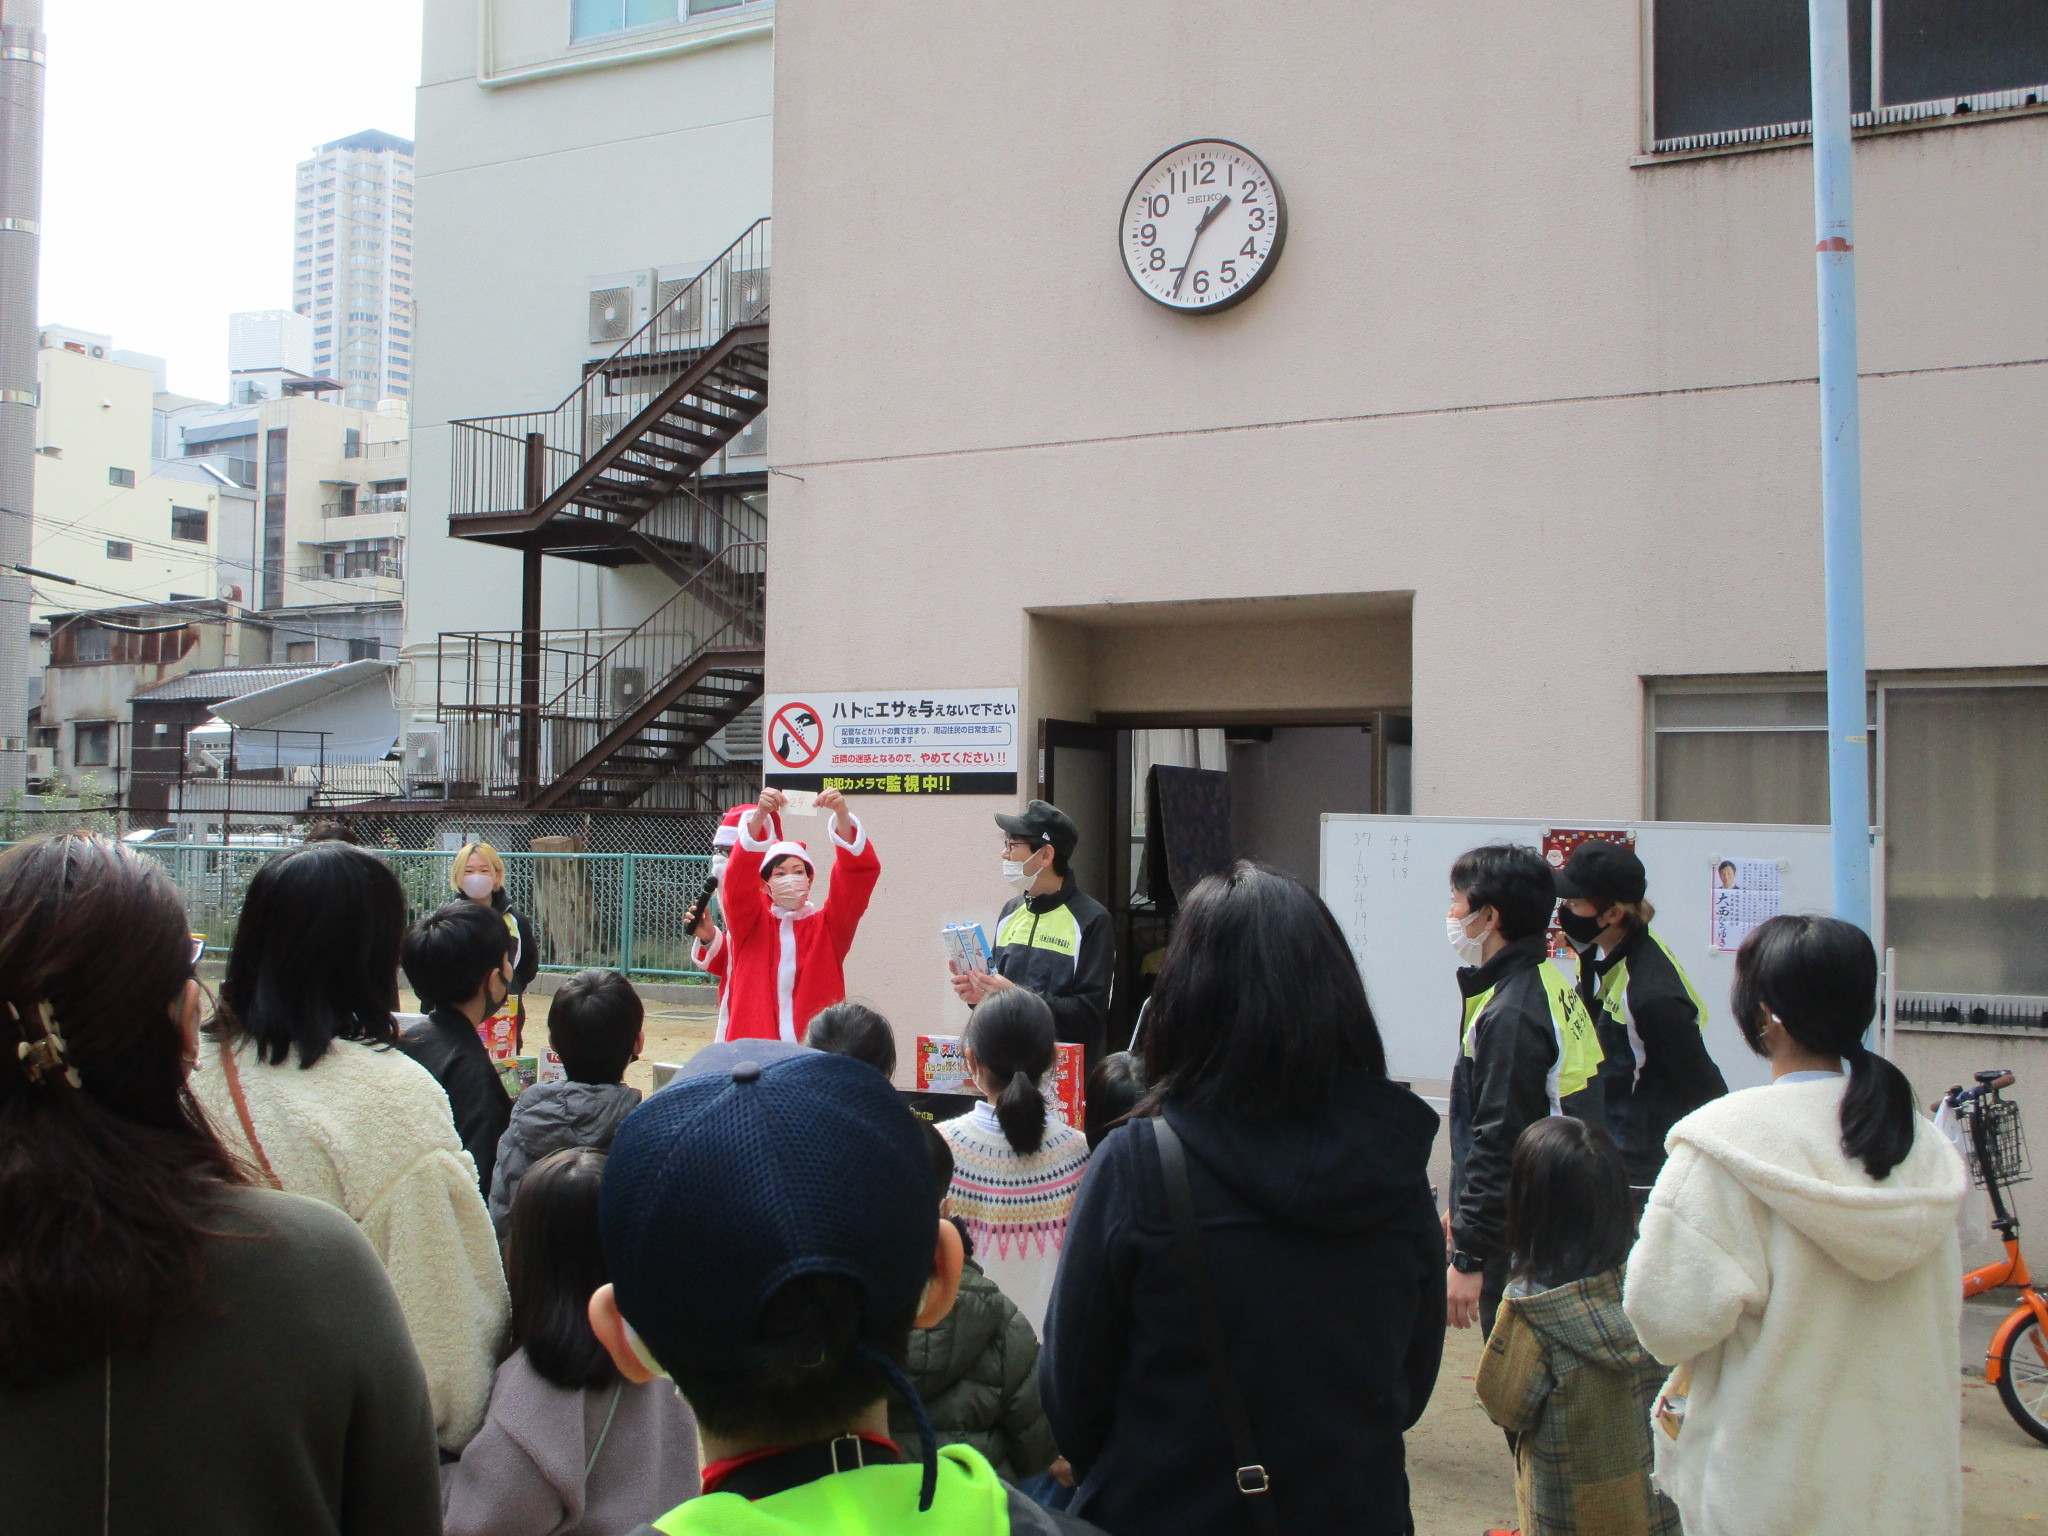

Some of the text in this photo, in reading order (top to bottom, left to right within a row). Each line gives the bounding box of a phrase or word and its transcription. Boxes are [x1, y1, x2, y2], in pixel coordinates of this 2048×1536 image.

[1171, 170, 1187, 195] 11
[1193, 161, 1215, 185] 12
[1228, 164, 1233, 187] 1
[1187, 193, 1223, 205] SEIKO
[1242, 180, 1258, 204] 2
[1148, 194, 1170, 219] 10
[1248, 207, 1266, 232] 3
[1140, 223, 1157, 247] 9
[1149, 247, 1166, 271] 8
[1239, 236, 1257, 259] 4
[1169, 267, 1187, 290] 7
[1192, 270, 1210, 294] 6
[1219, 259, 1237, 283] 5
[832, 699, 1016, 719] ハトにエサを与えないで下さい
[1353, 832, 1371, 847] 37
[1390, 833, 1411, 847] 44
[1390, 850, 1408, 862] 26
[1354, 875, 1368, 888] 35
[1392, 867, 1408, 879] 18
[1354, 892, 1366, 909] 4
[1354, 911, 1367, 927] 19
